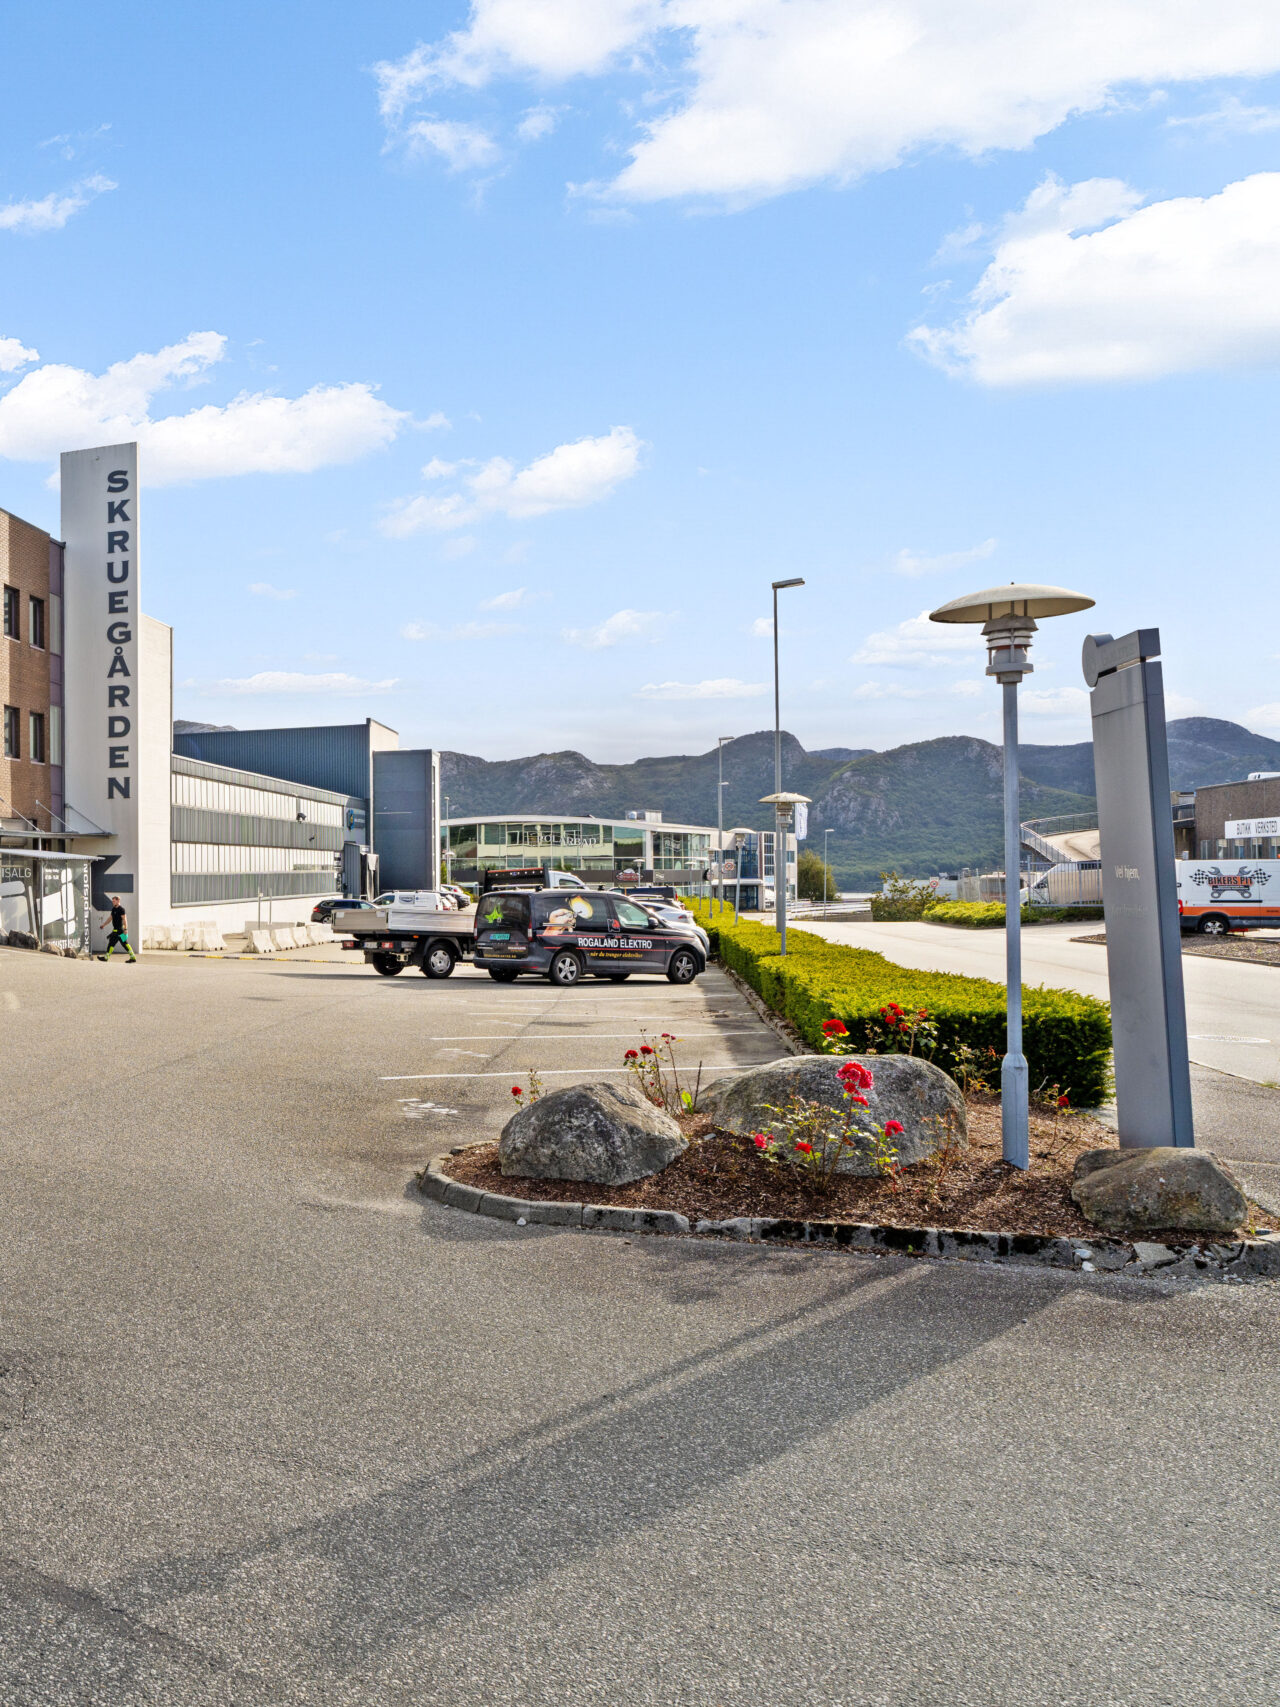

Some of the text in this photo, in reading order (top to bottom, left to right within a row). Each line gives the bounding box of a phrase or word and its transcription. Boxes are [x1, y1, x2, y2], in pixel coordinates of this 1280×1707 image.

[107, 470, 131, 799] SKRUEGÅRDEN
[538, 834, 597, 846] POLARBAD
[1208, 876, 1253, 885] BIKERS PIT
[578, 937, 653, 949] ROGALAND ELEKTRO
